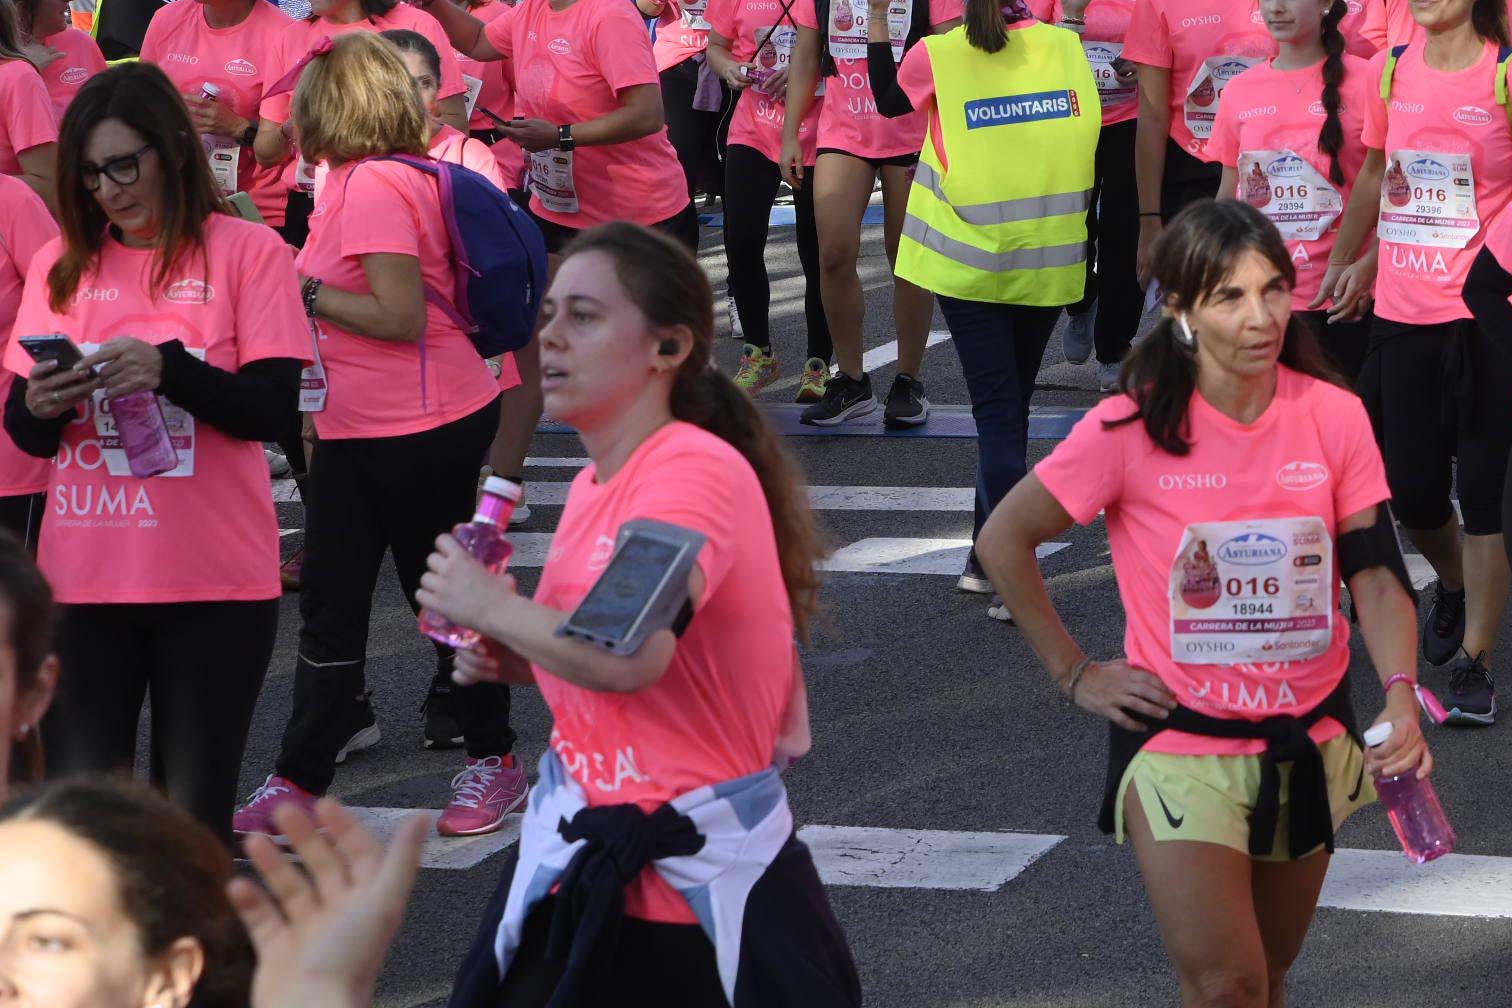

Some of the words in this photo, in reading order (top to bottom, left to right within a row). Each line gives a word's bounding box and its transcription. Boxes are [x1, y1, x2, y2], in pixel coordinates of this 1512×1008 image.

[1182, 14, 1222, 28] OYSHO
[967, 97, 1069, 122] VOLUNTARIS
[1238, 105, 1278, 121] OYSHO
[1408, 164, 1448, 178] ASTURIANA
[1274, 184, 1308, 199] 016
[1414, 186, 1447, 203] 016
[1277, 201, 1304, 212] 29394
[1415, 204, 1443, 215] 29396
[1391, 248, 1449, 273] UMA
[73, 287, 120, 306] YSHO
[1159, 473, 1227, 490] OYSHO
[1279, 471, 1328, 486] ASTURIANA
[55, 483, 156, 516] SUMA
[1221, 546, 1283, 559] ASTURIANA
[1226, 576, 1281, 597] 016
[1232, 603, 1274, 615] 18944
[1190, 622, 1233, 632] CARRERA
[1234, 622, 1249, 631] DE
[1250, 622, 1262, 631] LA
[1186, 640, 1236, 654] OYSHO
[1274, 639, 1321, 651] Santander
